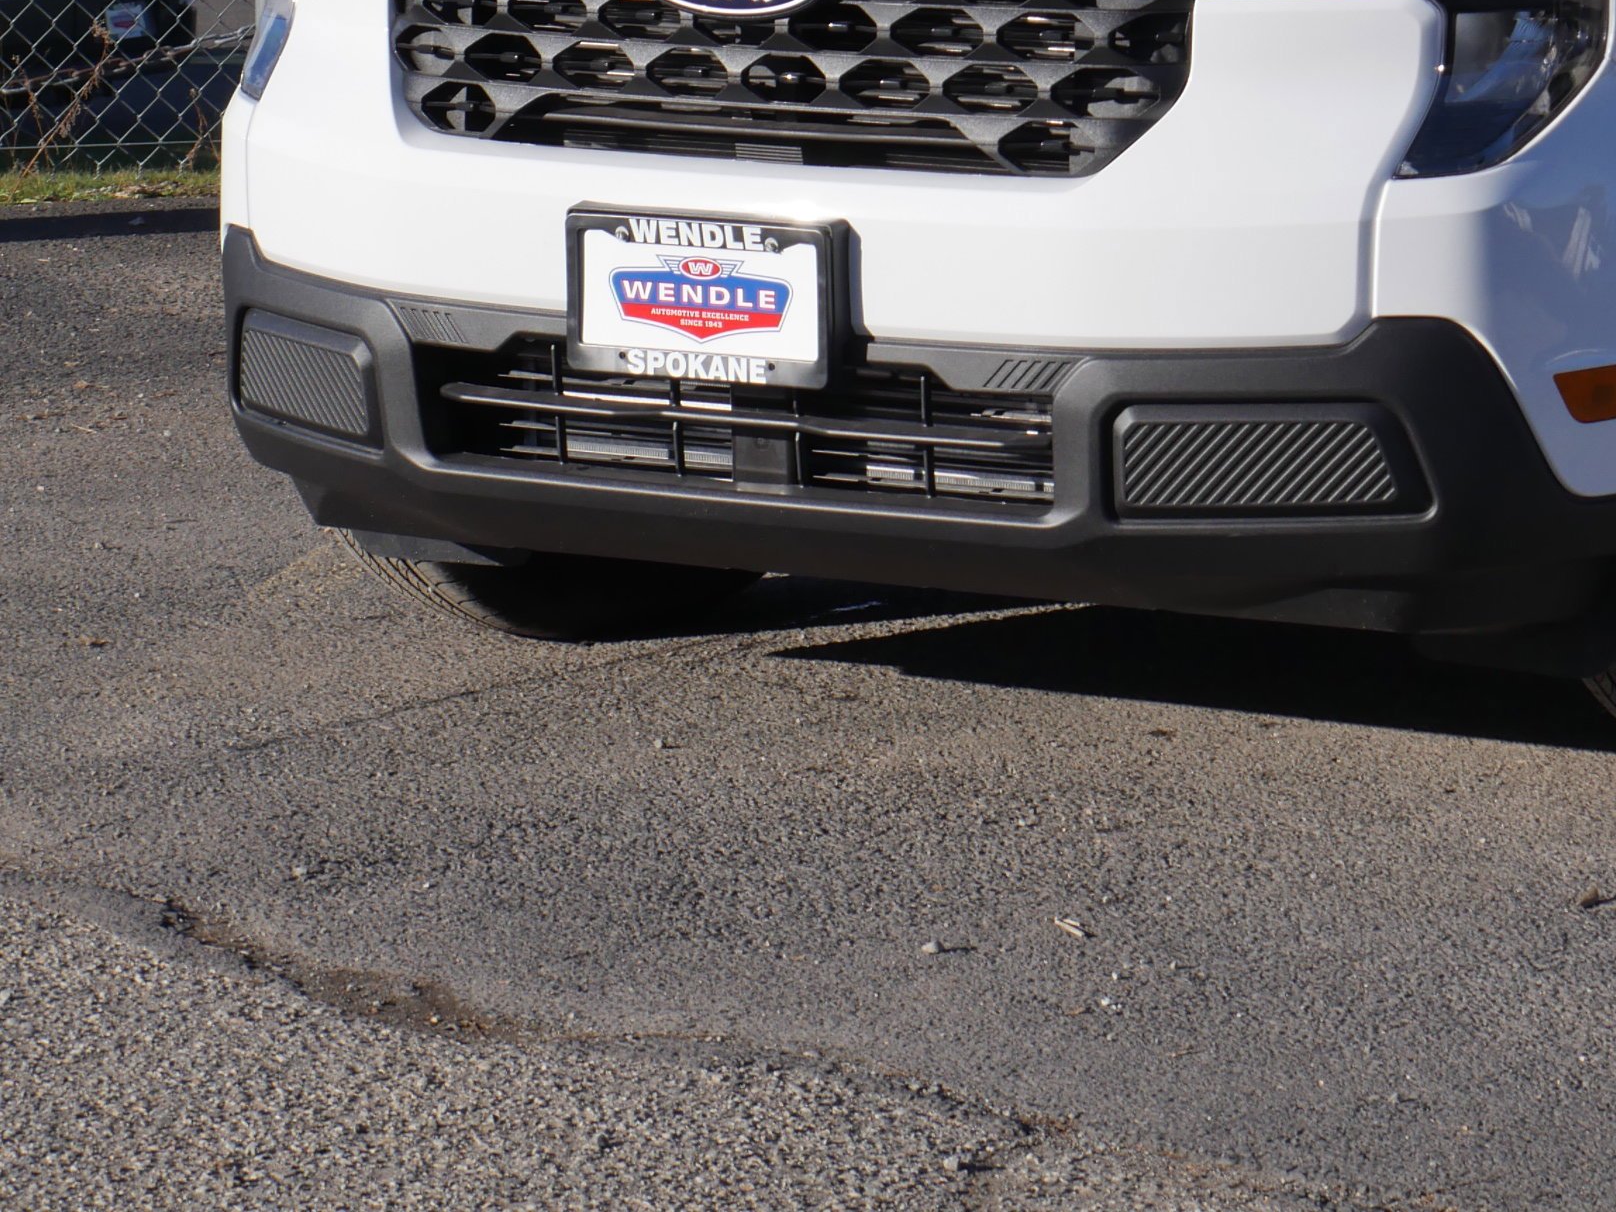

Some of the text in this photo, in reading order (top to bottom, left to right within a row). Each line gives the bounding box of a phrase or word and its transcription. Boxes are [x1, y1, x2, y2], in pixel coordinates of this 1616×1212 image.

[628, 218, 766, 252] WENDLE
[622, 279, 777, 310] WENDLE
[650, 307, 750, 322] AUTOMOTIVE EXCELLENCE
[679, 318, 723, 329] SINCE 1943
[626, 348, 768, 384] SPOKANE
